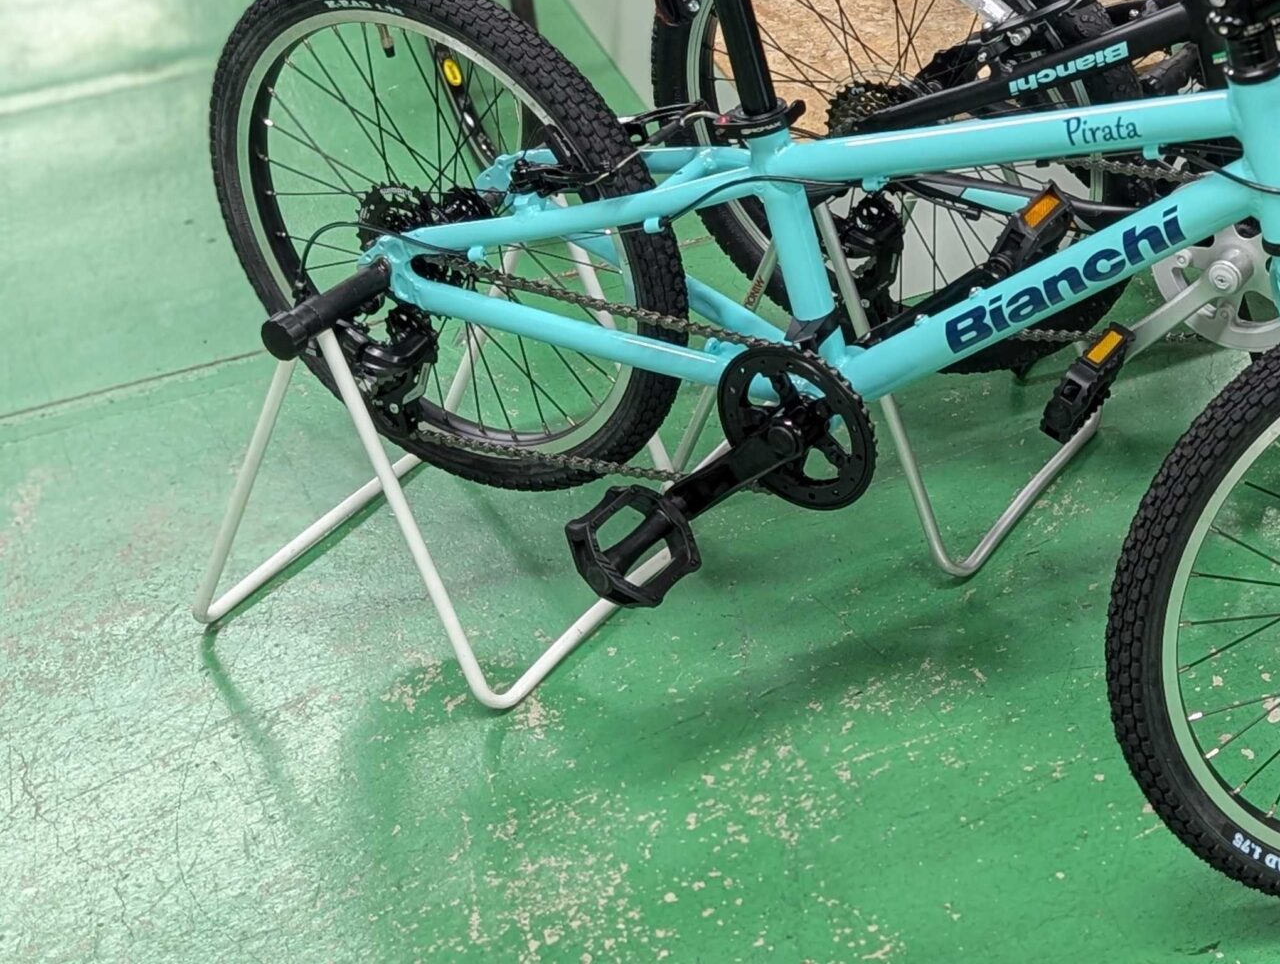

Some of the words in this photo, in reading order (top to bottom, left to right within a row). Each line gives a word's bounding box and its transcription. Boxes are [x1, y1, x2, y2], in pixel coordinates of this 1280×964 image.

[1008, 40, 1130, 97] Bianchi
[1063, 116, 1143, 147] Pirata
[945, 204, 1187, 355] Bianchi
[1232, 832, 1262, 860] 1.75
